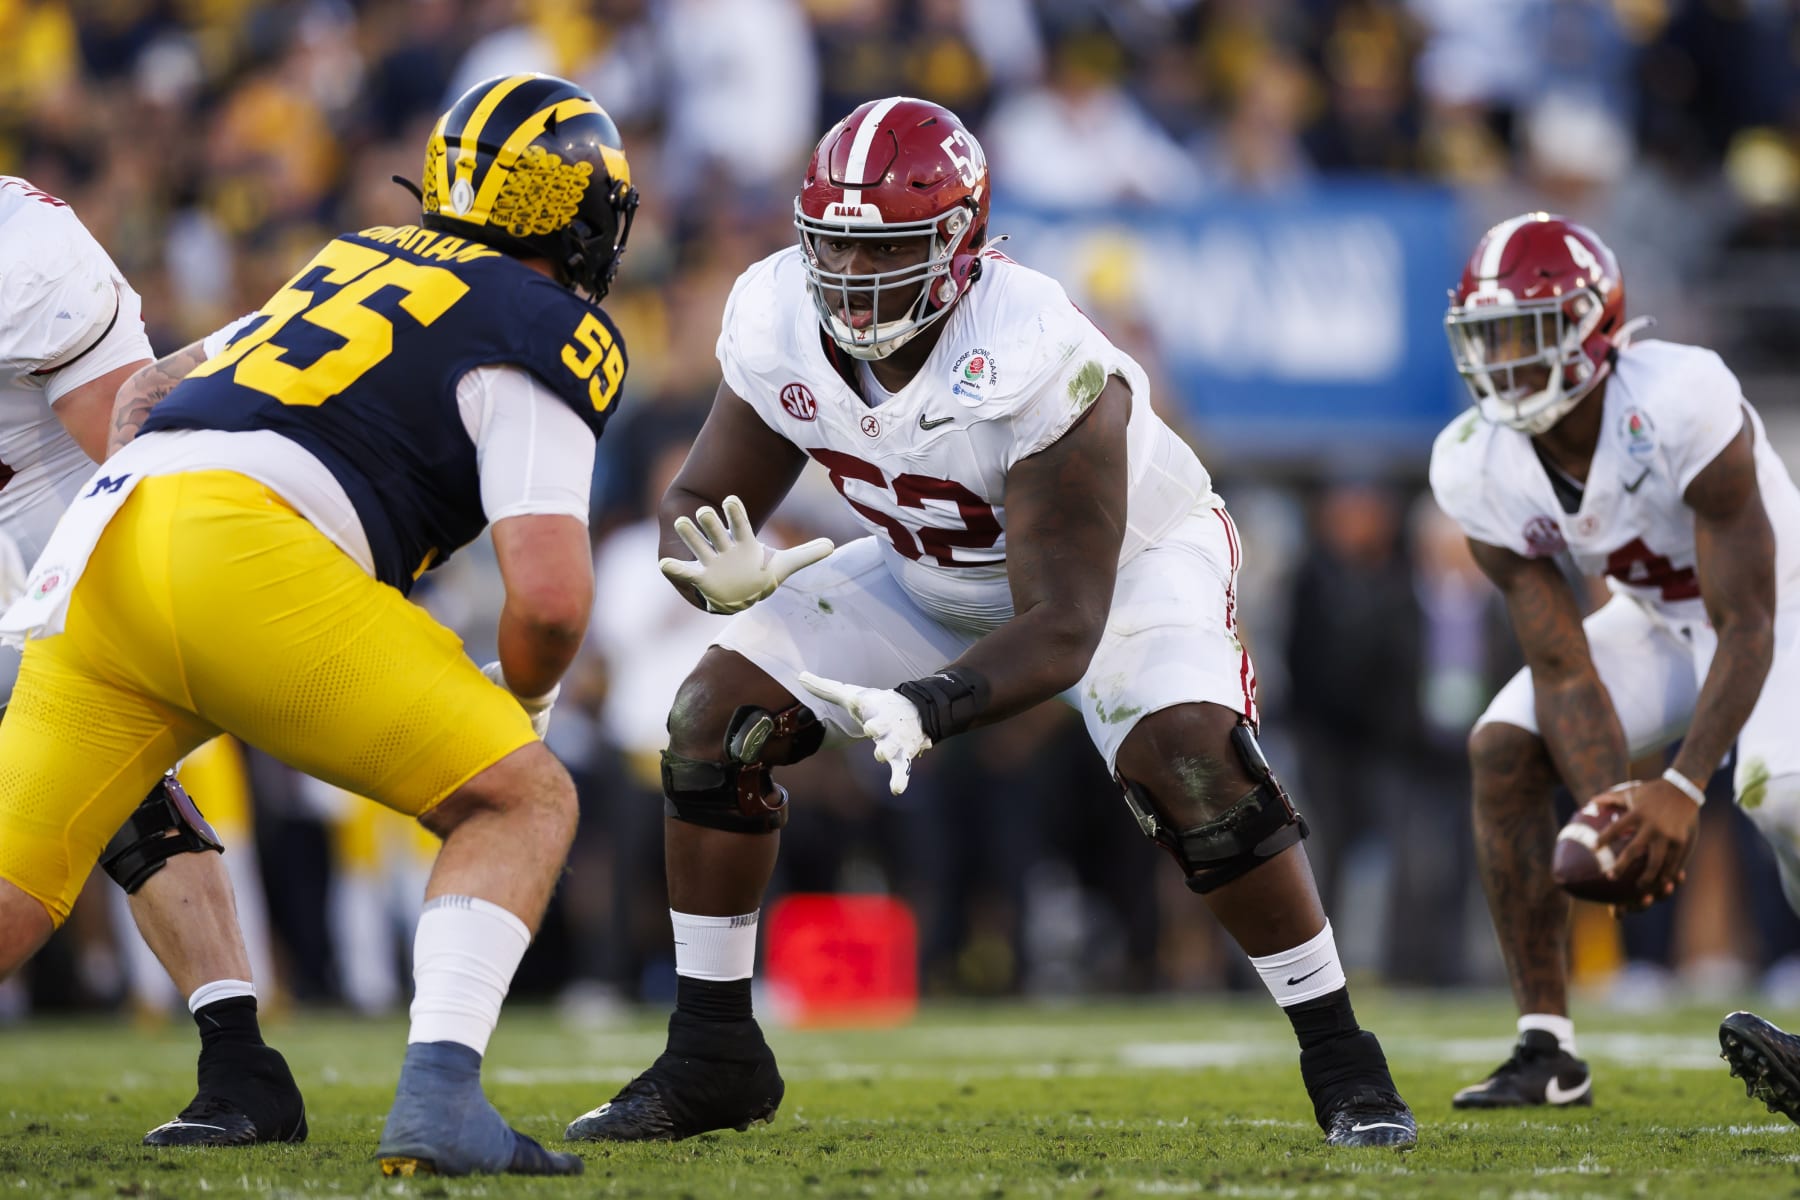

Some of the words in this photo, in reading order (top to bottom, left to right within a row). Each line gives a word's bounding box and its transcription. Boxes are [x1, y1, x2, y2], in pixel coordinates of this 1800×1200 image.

[940, 129, 985, 188] 52
[834, 206, 863, 217] BAMA
[1563, 234, 1603, 283] 4
[184, 239, 471, 407] 55
[561, 312, 625, 412] 59
[953, 351, 970, 372] ROSE
[972, 348, 991, 360] BOWL
[988, 358, 997, 386] GAME
[782, 385, 815, 418] SEC
[84, 473, 133, 499] M
[806, 447, 1007, 568] 52
[1604, 535, 1702, 604] 4
